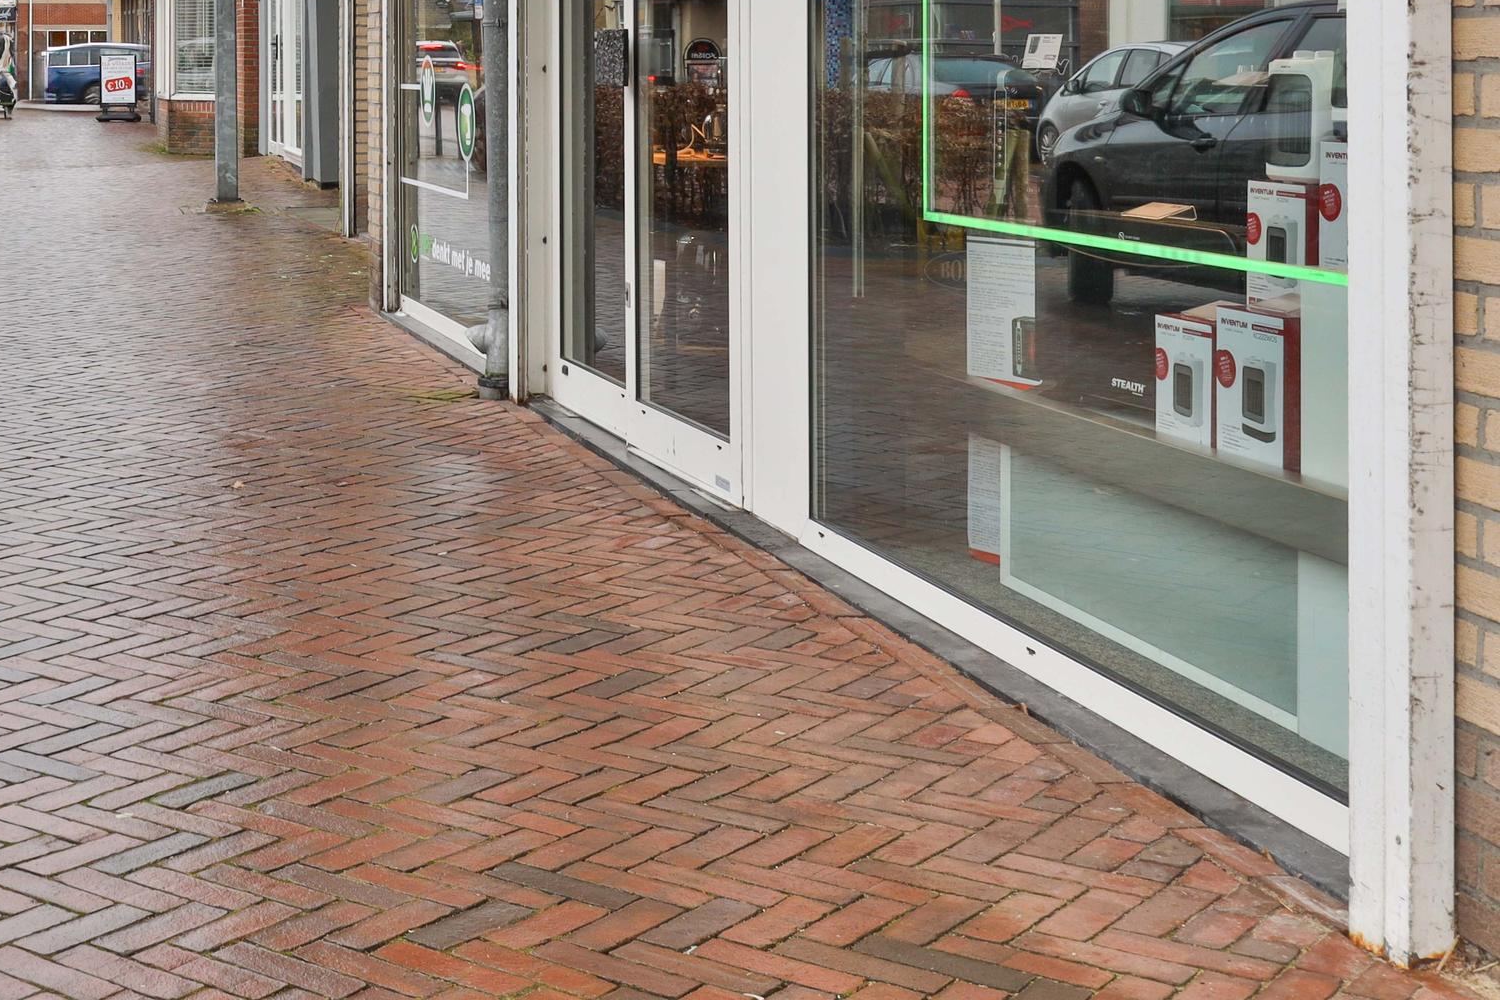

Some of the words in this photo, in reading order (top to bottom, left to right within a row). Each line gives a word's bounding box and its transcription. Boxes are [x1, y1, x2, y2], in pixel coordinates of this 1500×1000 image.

[1250, 186, 1274, 196] INVENTUM
[432, 237, 450, 265] denkt
[451, 250, 465, 271] met
[465, 249, 473, 277] je
[474, 258, 491, 281] mee
[1157, 322, 1180, 333] INVENTUM
[1220, 317, 1248, 330] INVENTUM
[1111, 377, 1145, 394] STEALTH
